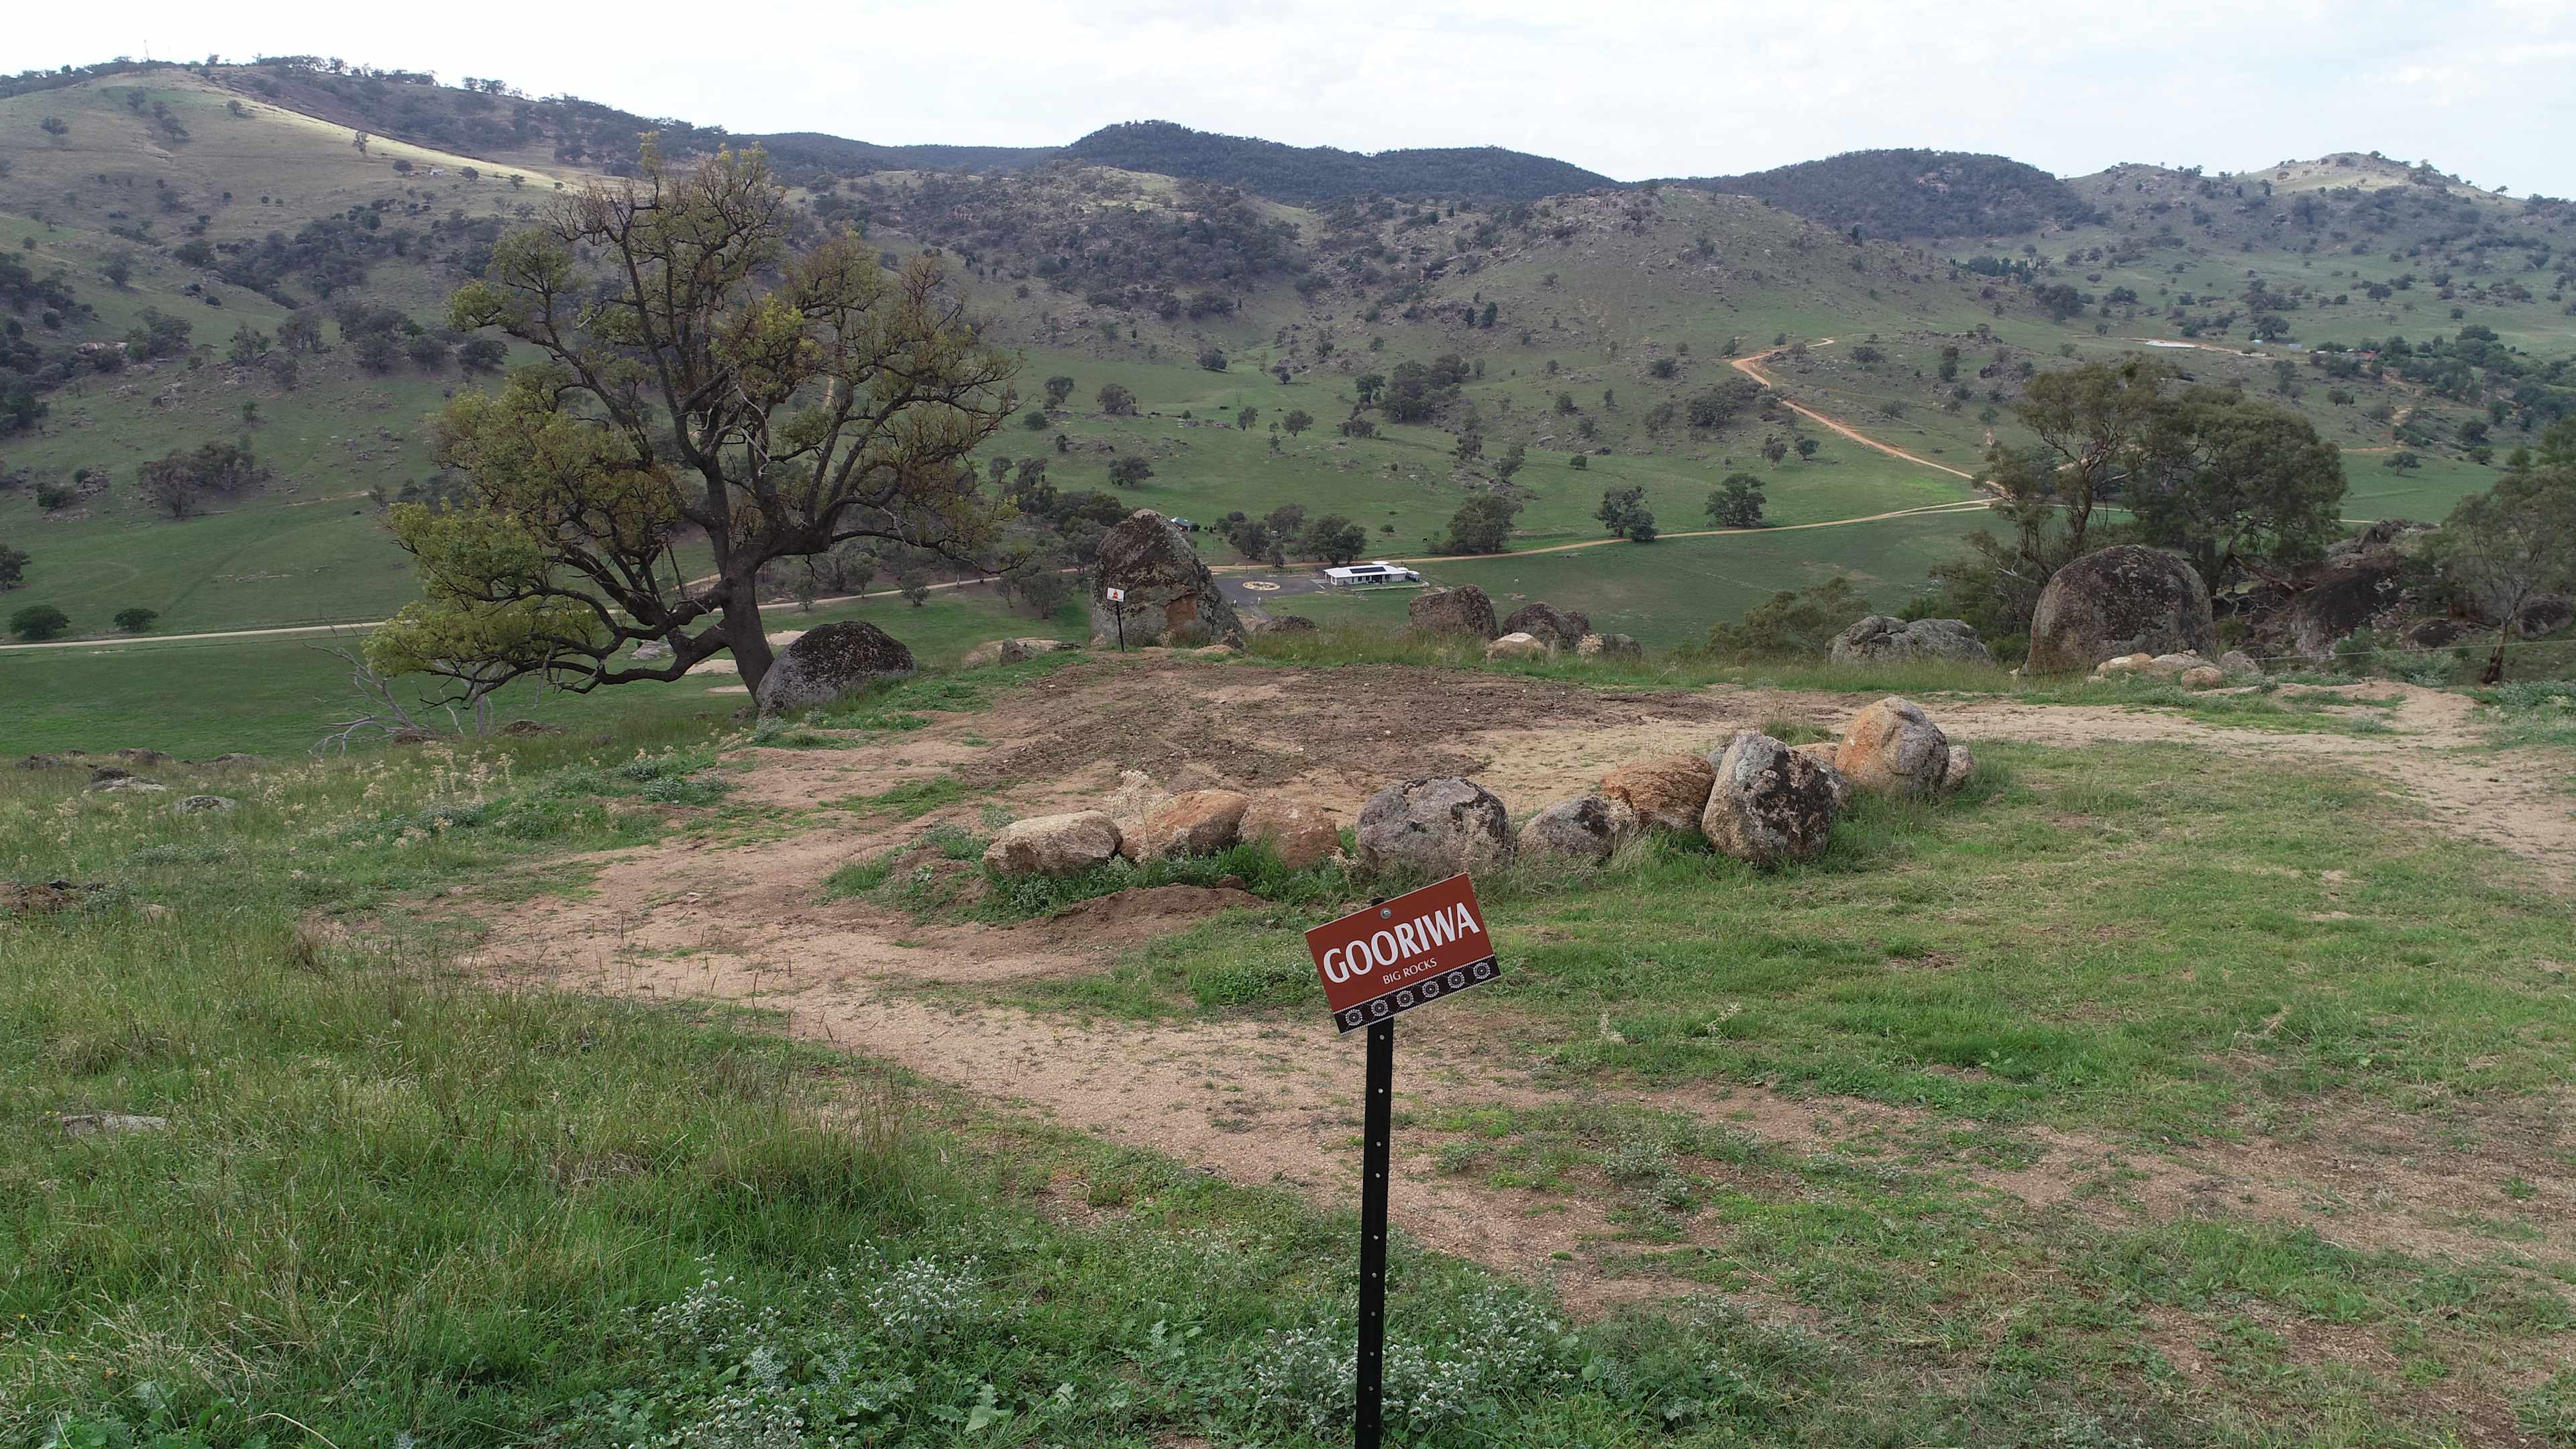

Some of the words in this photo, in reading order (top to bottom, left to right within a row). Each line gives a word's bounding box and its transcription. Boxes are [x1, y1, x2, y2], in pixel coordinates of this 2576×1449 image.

[1324, 902, 1481, 983] GOORIWA
[1383, 971, 1401, 985] BIG
[1403, 957, 1438, 977] ROCKS
